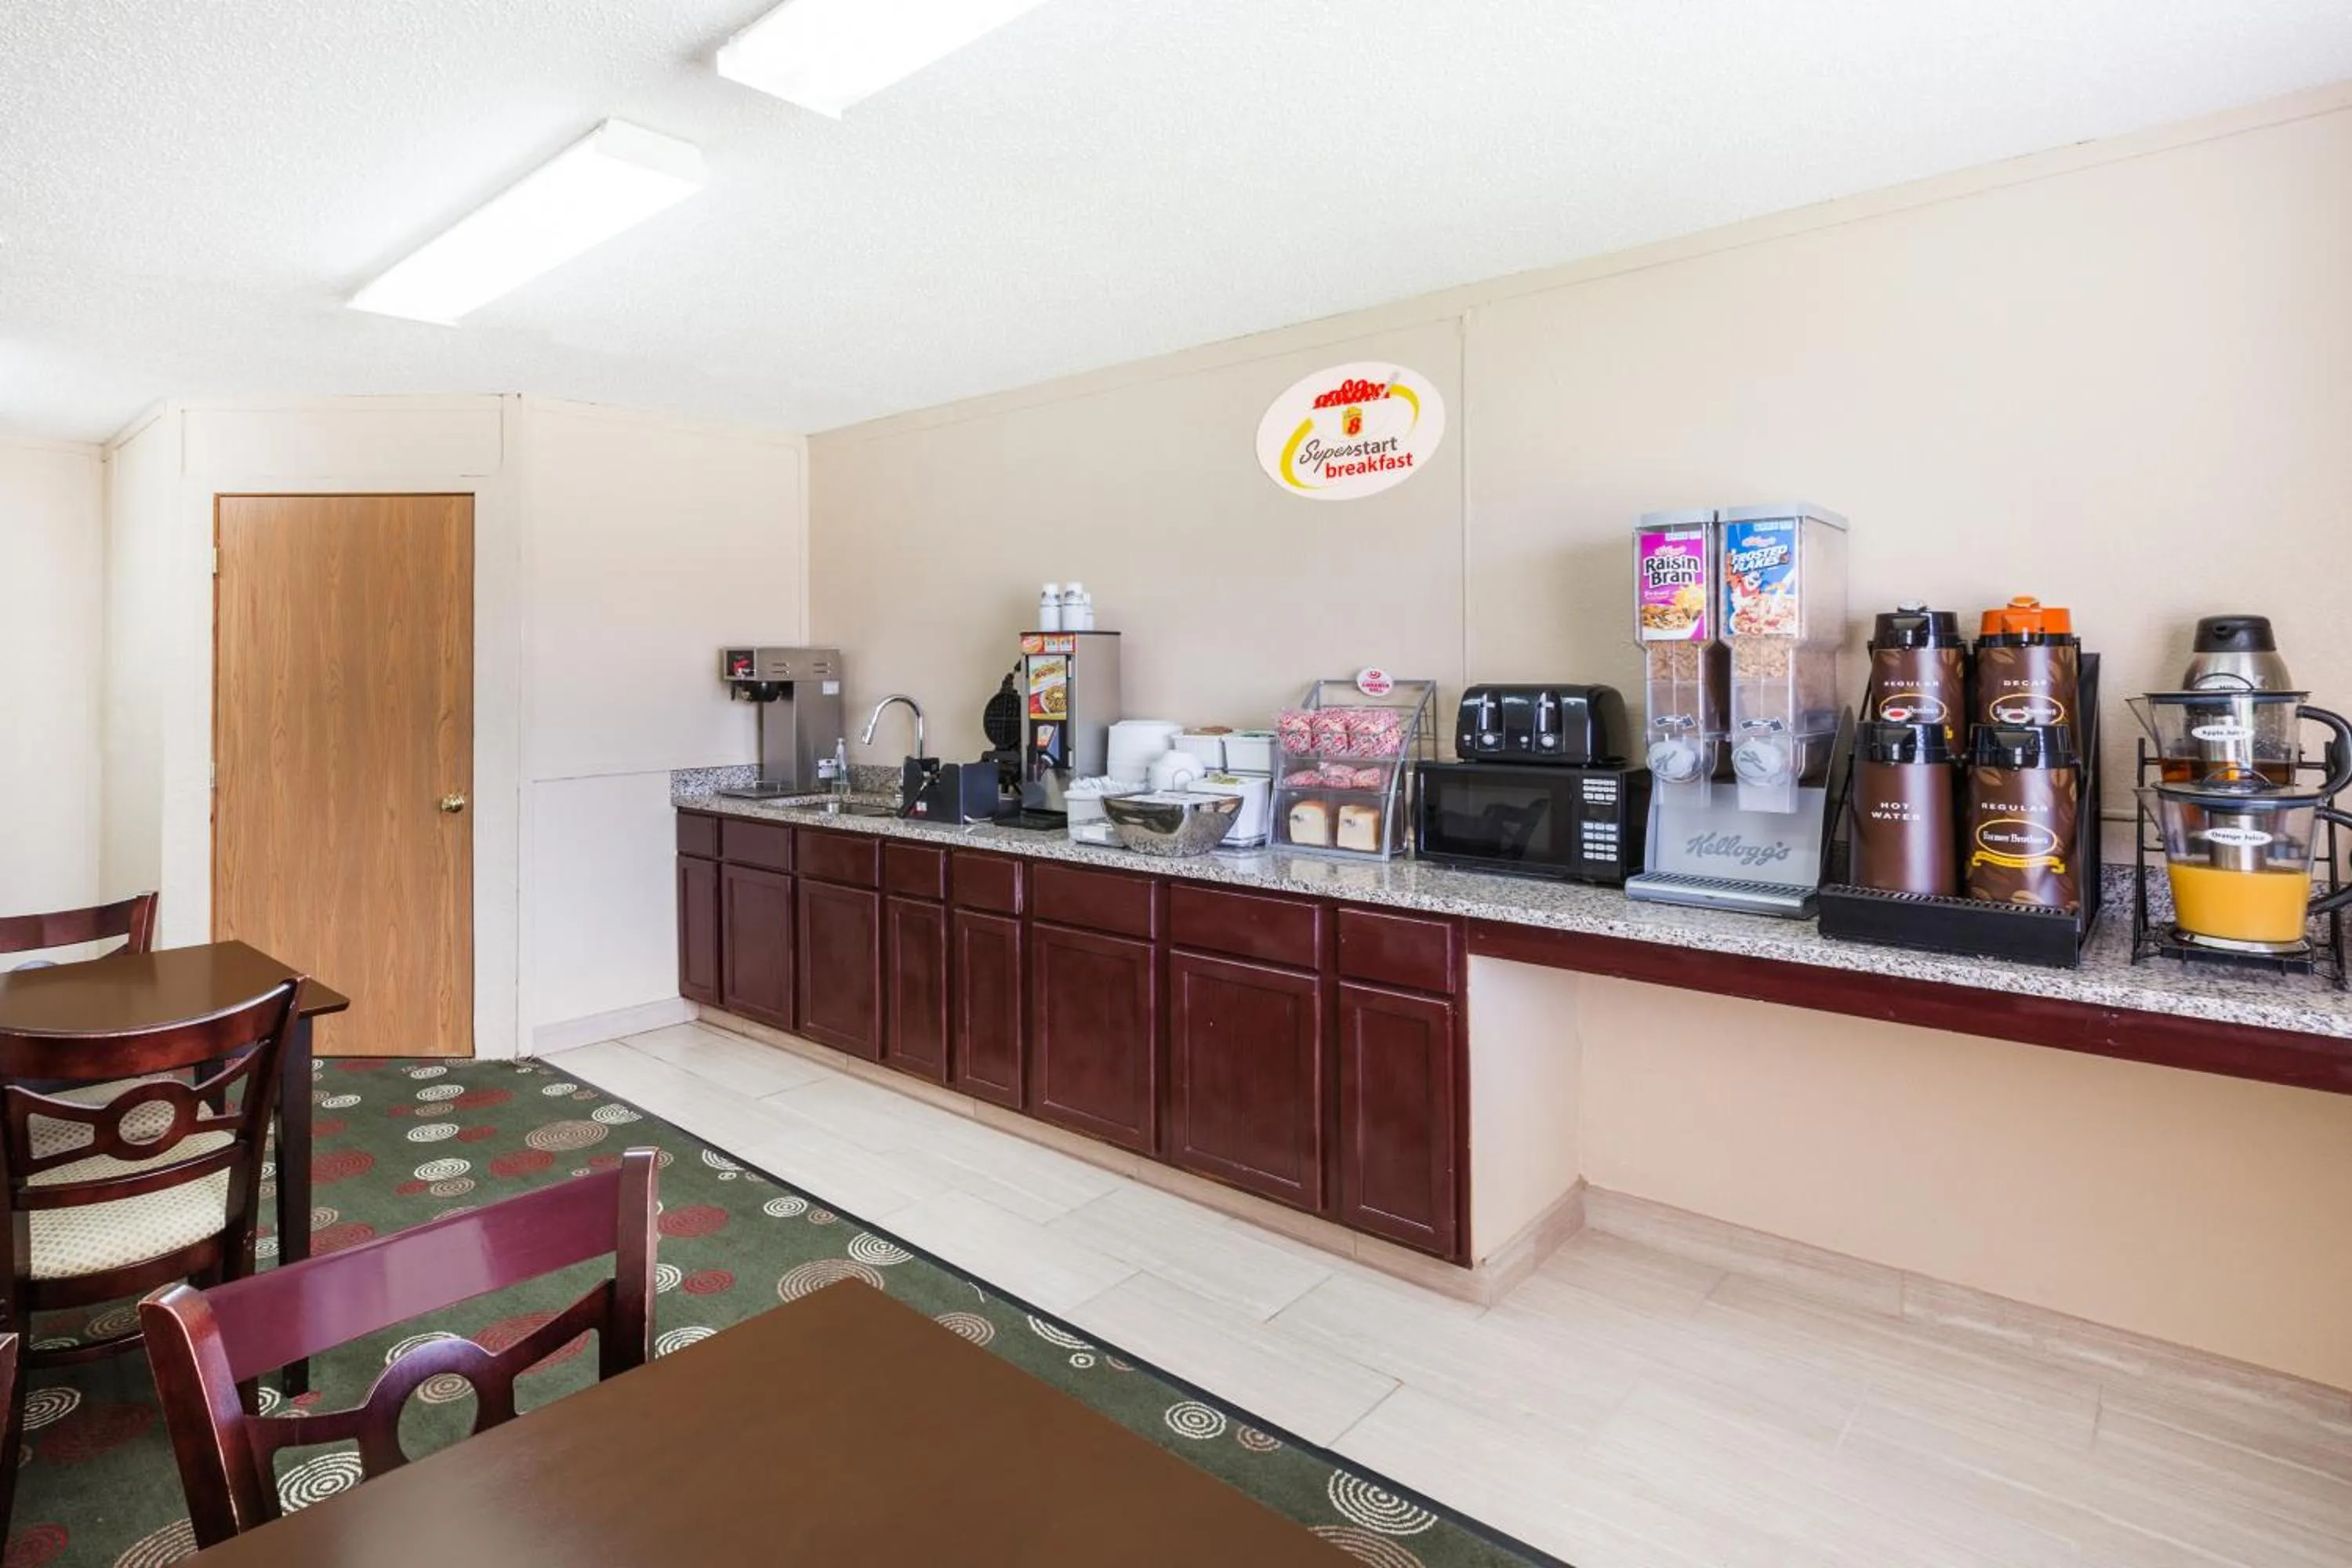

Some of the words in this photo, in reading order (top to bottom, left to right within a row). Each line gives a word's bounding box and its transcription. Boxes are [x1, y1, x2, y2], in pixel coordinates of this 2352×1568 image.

[1299, 437, 1398, 474] Superstart
[1325, 452, 1413, 479] breakfast
[1730, 546, 1788, 564] FROSTED
[1646, 556, 1699, 573] Raisin
[1651, 571, 1693, 586] Bran
[1880, 802, 1910, 811] HOT
[1981, 802, 2049, 813] REGULAR
[1871, 811, 1921, 822] WATER
[1686, 833, 1792, 866] Kellogg's
